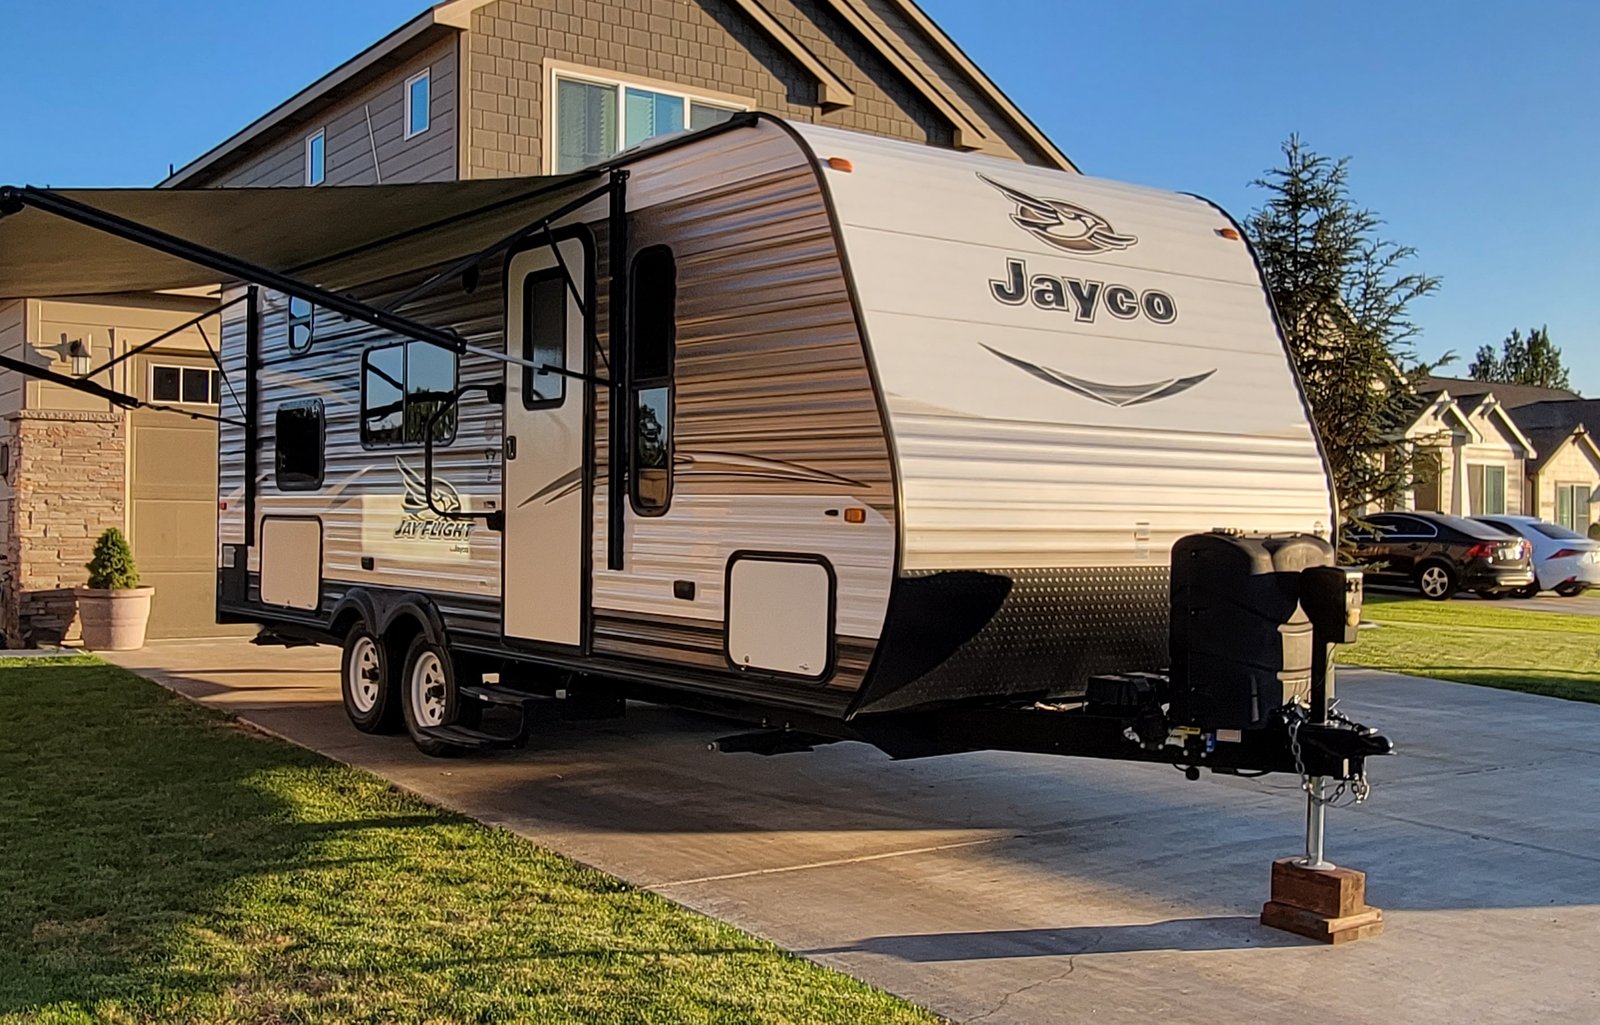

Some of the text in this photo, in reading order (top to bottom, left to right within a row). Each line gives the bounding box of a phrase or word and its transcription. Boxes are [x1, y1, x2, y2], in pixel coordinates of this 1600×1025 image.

[988, 257, 1177, 325] Jayco
[394, 519, 475, 540] JAY FLIGHT
